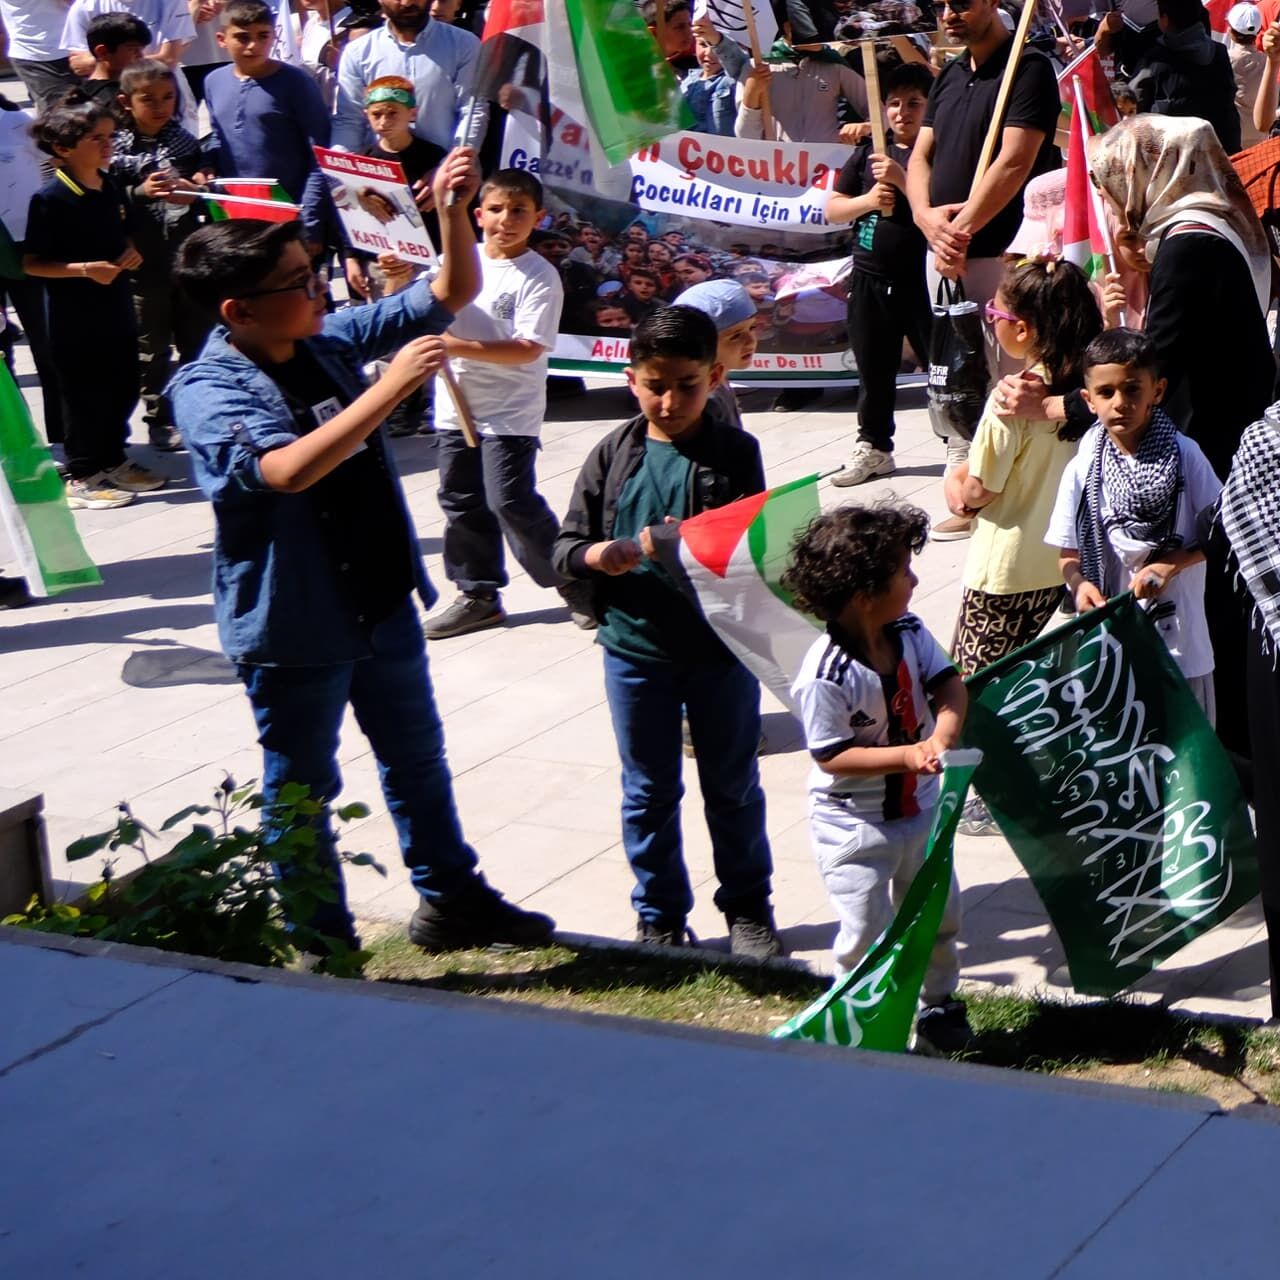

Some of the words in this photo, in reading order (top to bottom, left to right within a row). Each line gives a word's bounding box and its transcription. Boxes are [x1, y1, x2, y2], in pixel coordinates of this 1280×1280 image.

[631, 173, 741, 213] Çocukları
[752, 192, 789, 224] İçin
[398, 240, 430, 258] ABD
[776, 356, 797, 368] De
[803, 355, 822, 368] !!!
